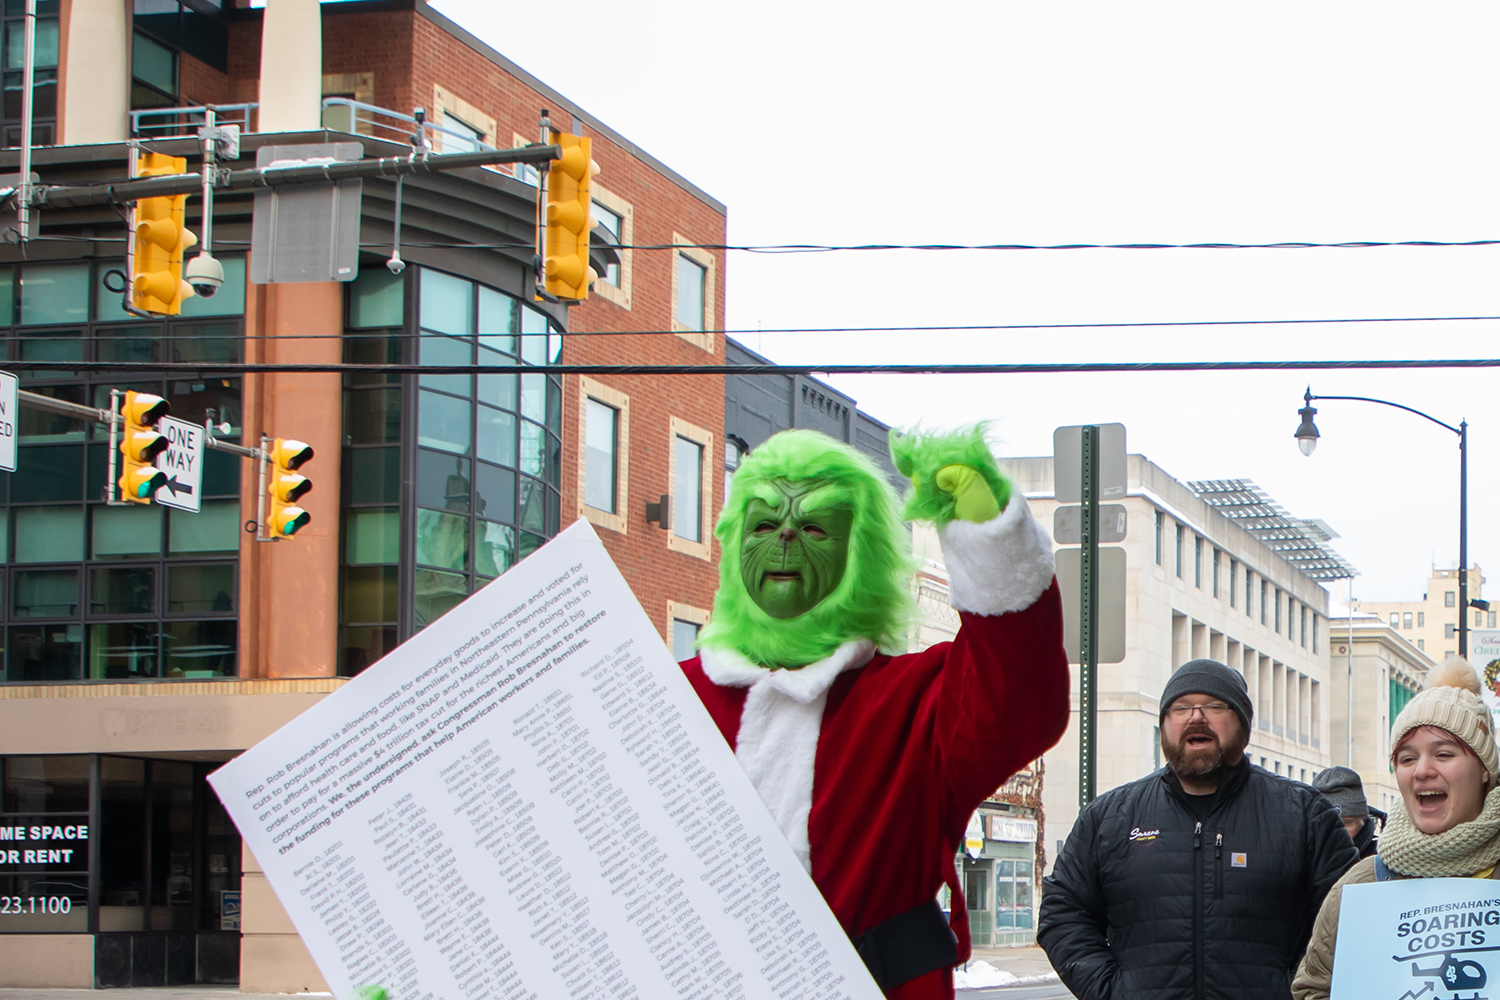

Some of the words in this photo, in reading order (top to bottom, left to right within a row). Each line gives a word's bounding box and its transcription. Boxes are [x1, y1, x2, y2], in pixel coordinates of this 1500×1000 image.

[167, 425, 195, 450] ONE
[166, 448, 194, 473] WAY
[245, 784, 266, 799] Rep.
[266, 769, 286, 784] Rob
[285, 738, 332, 772] Bresnahan
[331, 731, 341, 740] is
[341, 706, 379, 734] allowing
[378, 690, 401, 708] costs
[401, 680, 414, 692] for
[415, 654, 452, 683] everyday
[453, 635, 481, 658] goods
[480, 628, 491, 637] to
[490, 602, 527, 630] increase
[527, 588, 545, 605] and
[545, 570, 570, 591] voted
[570, 562, 583, 574] for
[252, 794, 272, 810] cuts
[272, 787, 283, 796] to
[283, 763, 317, 790] popular
[318, 734, 360, 767] programs
[360, 720, 379, 736] that
[379, 696, 416, 722] working
[415, 672, 450, 698] families
[449, 665, 460, 674] in
[459, 626, 516, 667] Northeastern
[515, 587, 572, 628] Pennsylvania
[572, 574, 589, 589] rely
[259, 810, 272, 821] on
[271, 803, 282, 812] to
[283, 782, 310, 805] afford
[309, 764, 339, 786] health
[339, 751, 358, 766] care
[359, 737, 377, 753] and
[376, 722, 400, 740] food,
[399, 711, 416, 724] like
[416, 692, 441, 713] SNAP
[442, 679, 460, 696] and
[459, 651, 502, 683] Medicaid.
[501, 636, 522, 653] They
[523, 626, 538, 639] are
[538, 608, 564, 628] doing
[564, 596, 582, 610] this
[581, 589, 592, 598] in
[266, 813, 289, 832] order
[290, 806, 301, 815] to
[301, 794, 317, 809] pay
[318, 785, 331, 796] for
[339, 756, 373, 782] massive
[373, 747, 386, 758] $4
[386, 727, 415, 750] trillion
[415, 717, 430, 729] tax
[430, 706, 446, 719] cut
[445, 696, 458, 708] for
[459, 686, 475, 699] the
[475, 664, 505, 688] richest
[506, 632, 552, 667] Americans
[552, 618, 569, 635] and
[569, 609, 586, 622] big
[272, 804, 328, 844] corporations.
[327, 792, 347, 804] We,
[346, 779, 362, 793] the
[362, 739, 421, 782] undersigned,
[421, 728, 437, 742] ask
[437, 686, 498, 730] Congressman
[496, 673, 516, 688] Rob
[515, 640, 564, 675] Bresnahan
[563, 632, 574, 642] to
[574, 610, 607, 634] restore
[278, 841, 295, 855] the
[294, 816, 332, 844] funding
[330, 806, 344, 819] for
[344, 789, 371, 809] these
[371, 759, 414, 794] programs
[414, 745, 434, 762] that
[433, 731, 455, 748] help
[456, 701, 499, 734] American
[498, 676, 535, 703] workers
[534, 661, 553, 678] and
[552, 638, 591, 665] families.
[29, 824, 89, 840] SPACE
[23, 848, 74, 864] RENT
[1396, 910, 1500, 938] SOARING
[1399, 909, 1422, 921] REP.
[1407, 929, 1487, 953] COSTS
